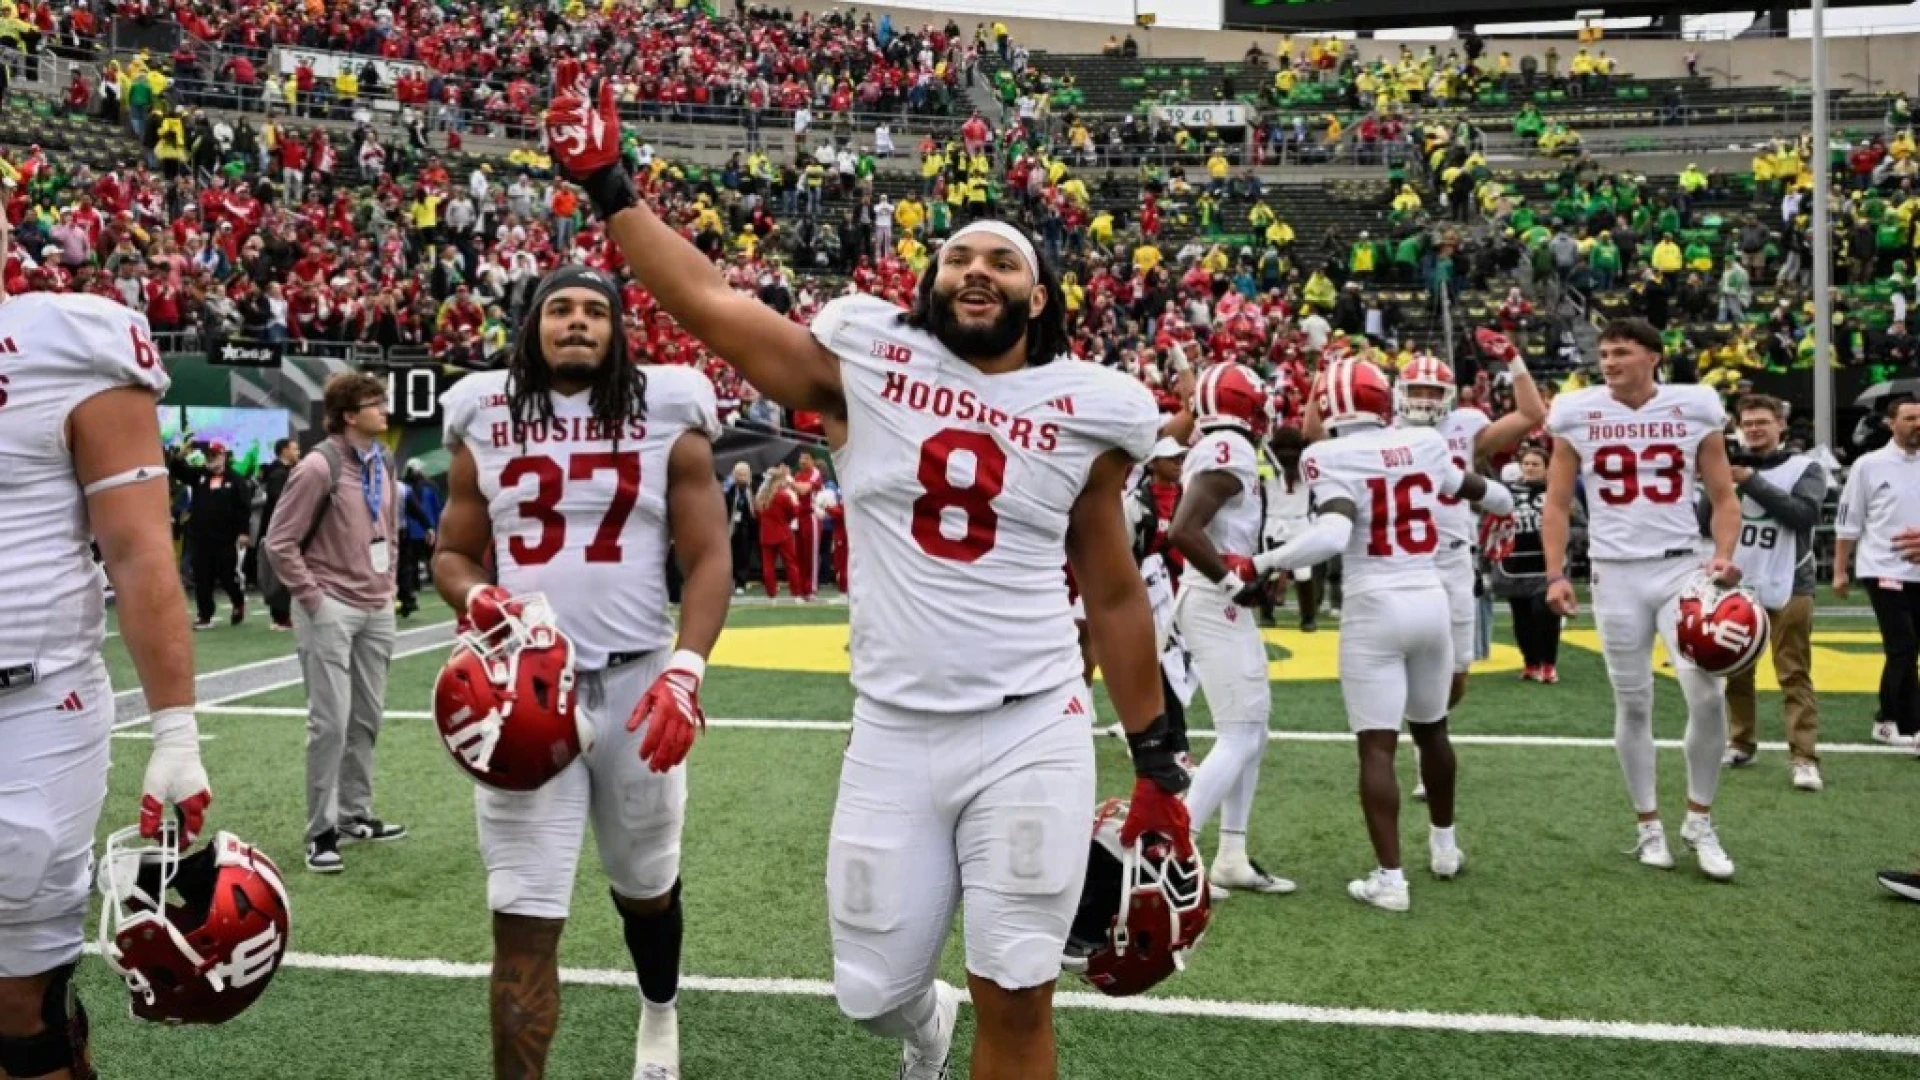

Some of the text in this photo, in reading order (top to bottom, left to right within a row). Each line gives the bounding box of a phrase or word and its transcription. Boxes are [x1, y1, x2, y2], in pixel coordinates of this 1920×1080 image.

[1192, 107, 1213, 123] 40
[1227, 109, 1236, 122] 1
[881, 371, 1059, 451] HOOSIERS
[1588, 422, 1687, 440] HOOSIERS
[1215, 442, 1231, 464] 3
[1593, 443, 1685, 505] 93
[499, 453, 642, 566] 37
[911, 428, 1007, 563] 8
[1366, 472, 1438, 557] 16
[1741, 524, 1778, 549] 09
